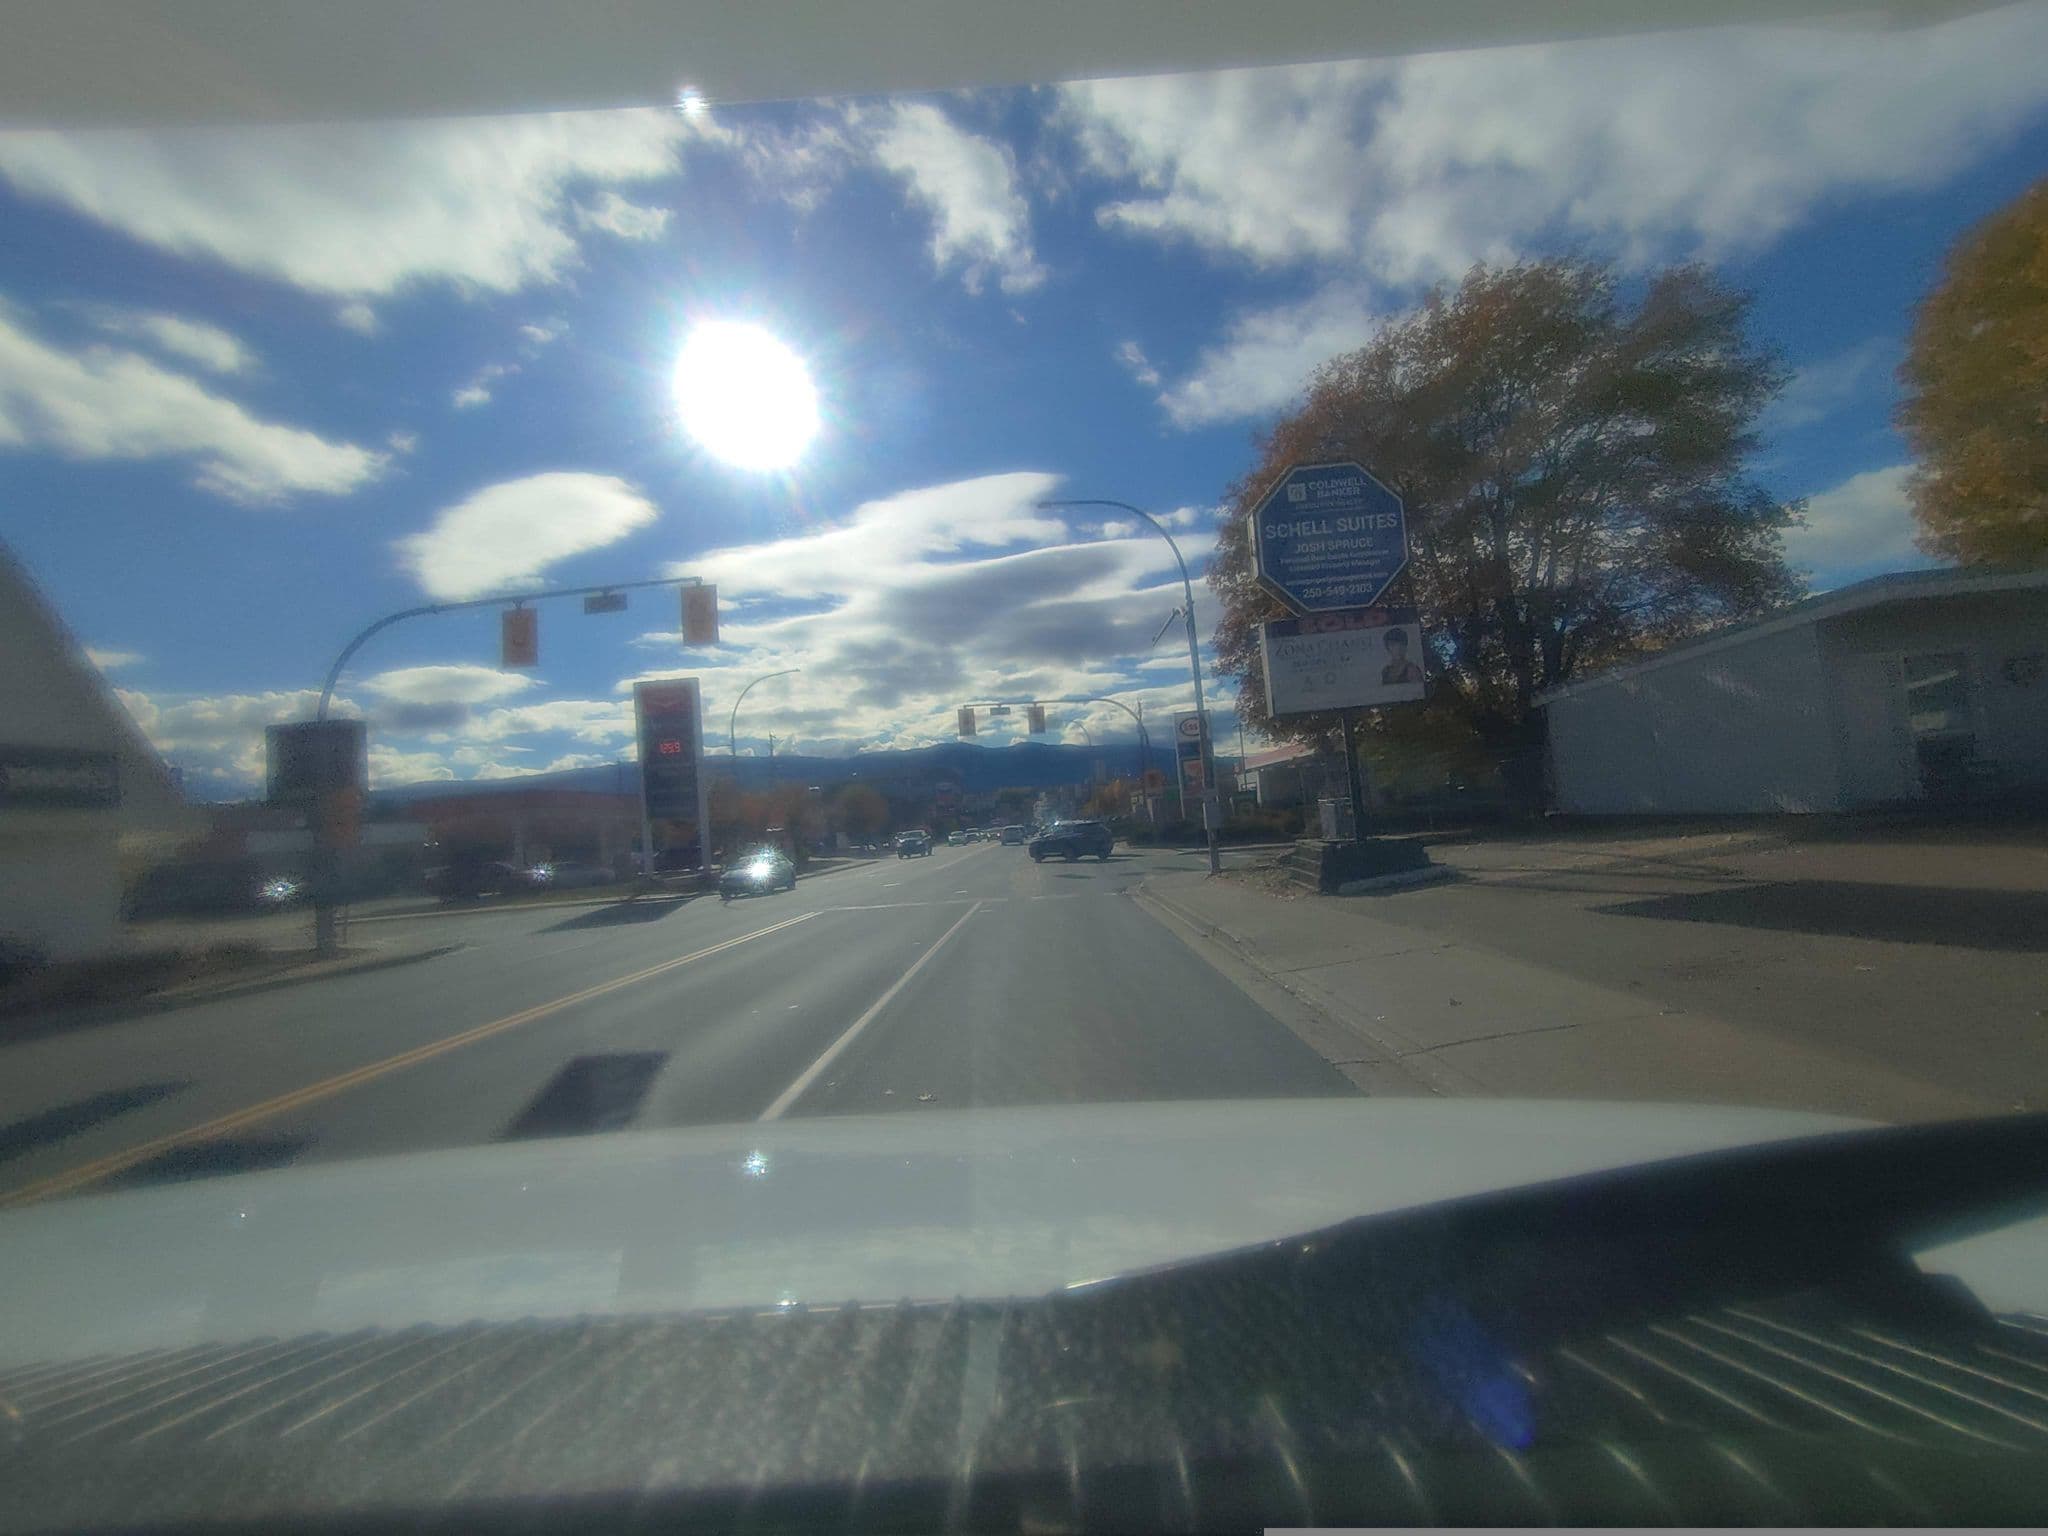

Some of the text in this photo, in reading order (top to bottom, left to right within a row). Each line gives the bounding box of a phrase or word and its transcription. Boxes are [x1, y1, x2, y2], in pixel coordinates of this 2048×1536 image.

[1308, 477, 1368, 491] COLDWELL
[1317, 488, 1360, 499] BANKER
[1265, 512, 1398, 540] SCHELL SUITES
[1295, 537, 1374, 554] JOSH SPRUCE
